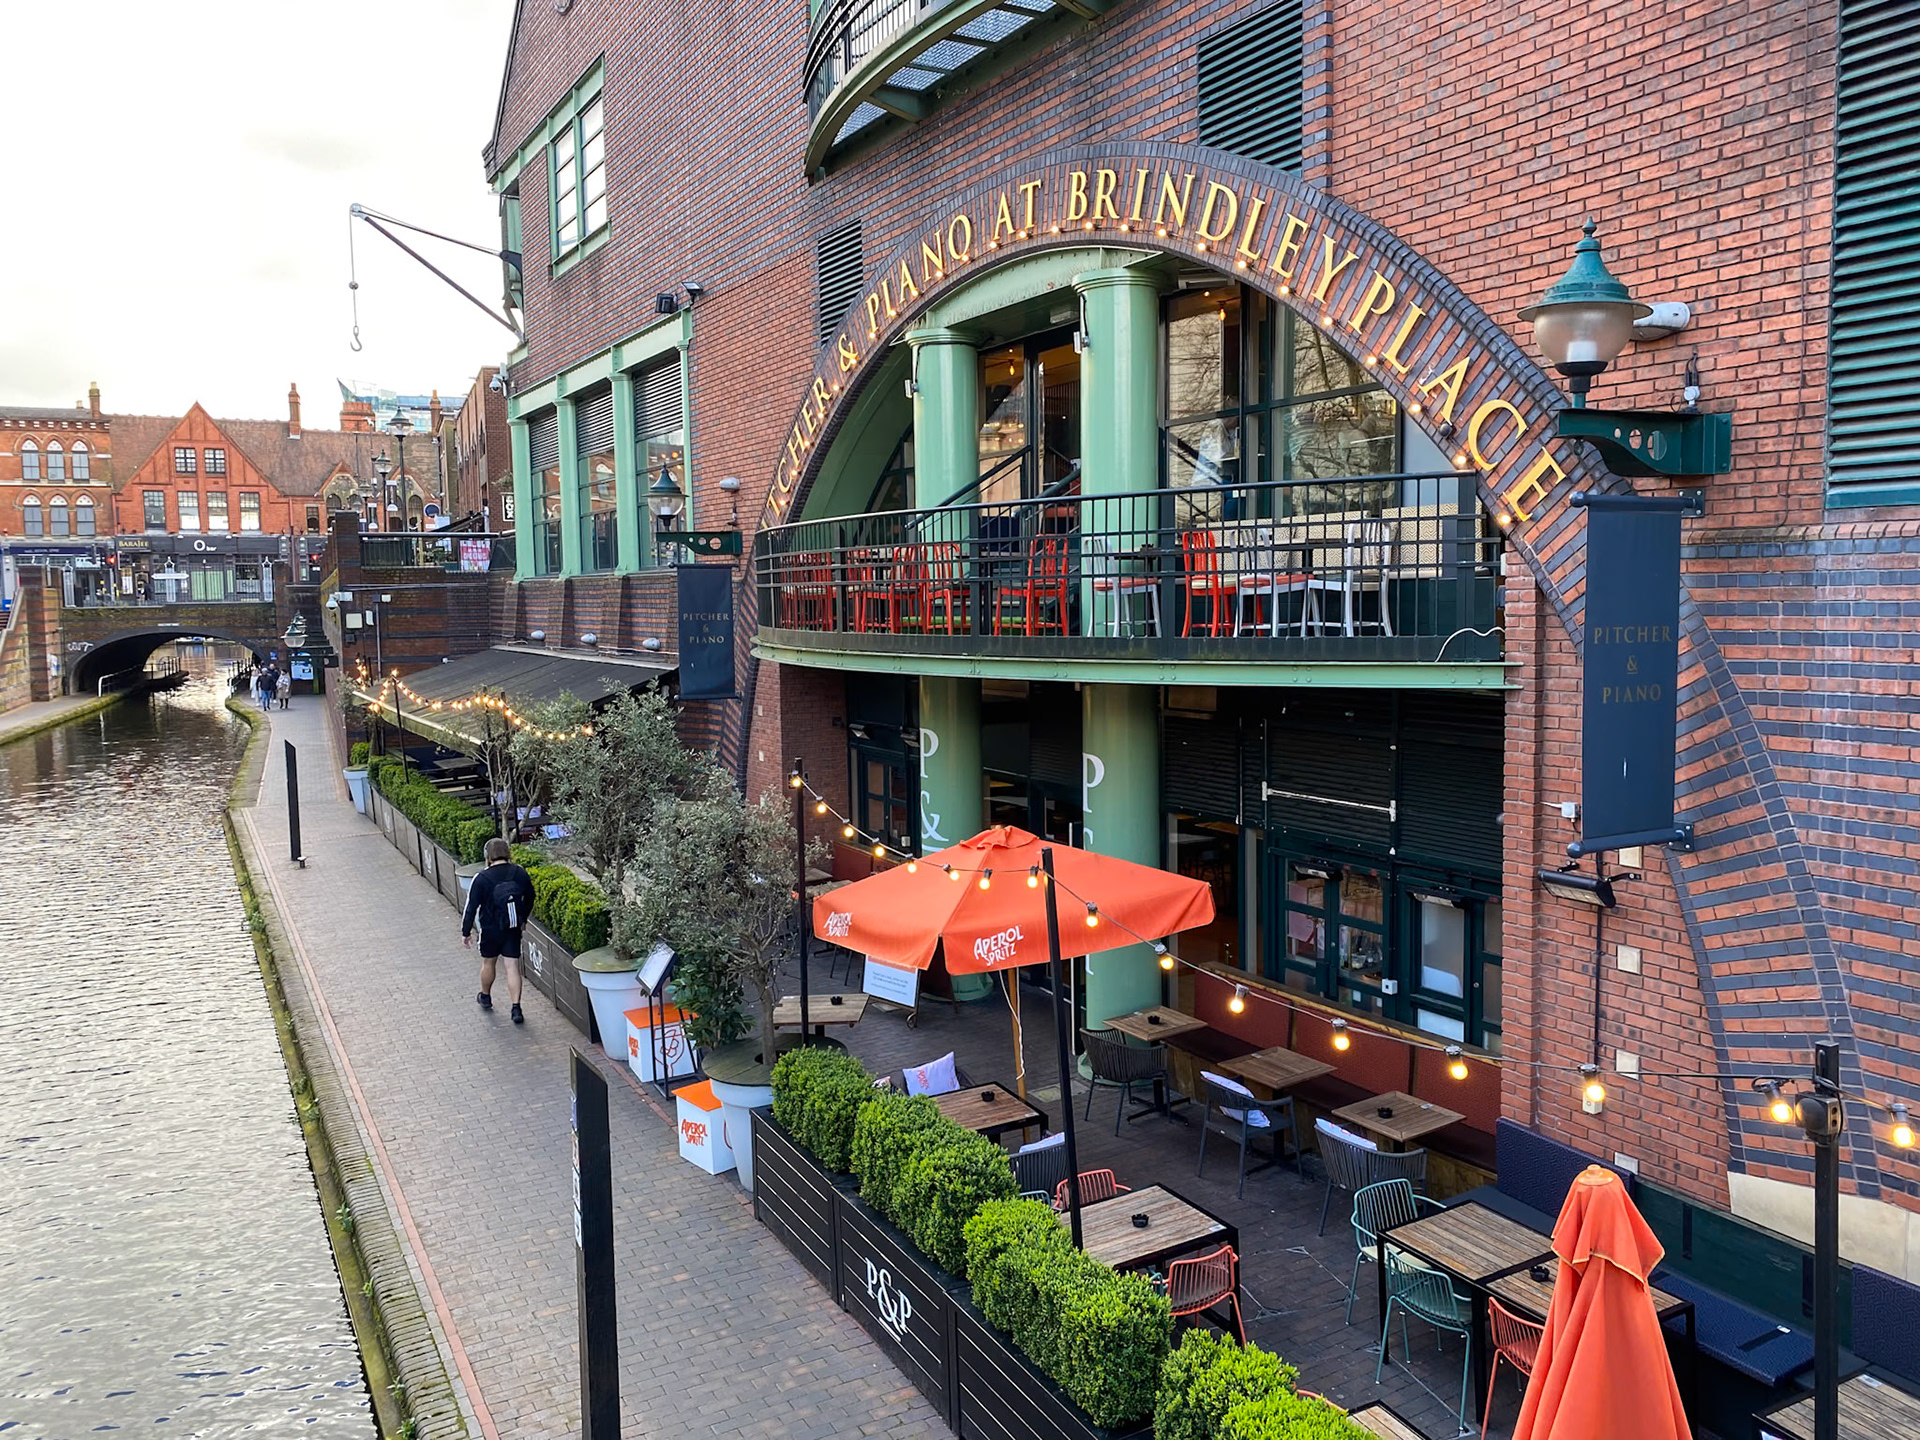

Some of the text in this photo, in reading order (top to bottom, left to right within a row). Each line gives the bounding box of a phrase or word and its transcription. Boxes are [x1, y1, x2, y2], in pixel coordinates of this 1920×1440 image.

[761, 376, 832, 529] TCHER
[838, 333, 859, 372] &
[866, 214, 972, 333] PIANO
[994, 179, 1042, 240] AT
[193, 539, 206, 551] O
[683, 612, 730, 622] PITCHER
[702, 623, 710, 634] &
[1593, 625, 1674, 645] PITCHER
[689, 635, 725, 644] PIANO
[1626, 654, 1639, 674] &
[1602, 683, 1662, 704] PIANO
[973, 925, 1025, 960] APEROL
[681, 1118, 708, 1137] APEROL
